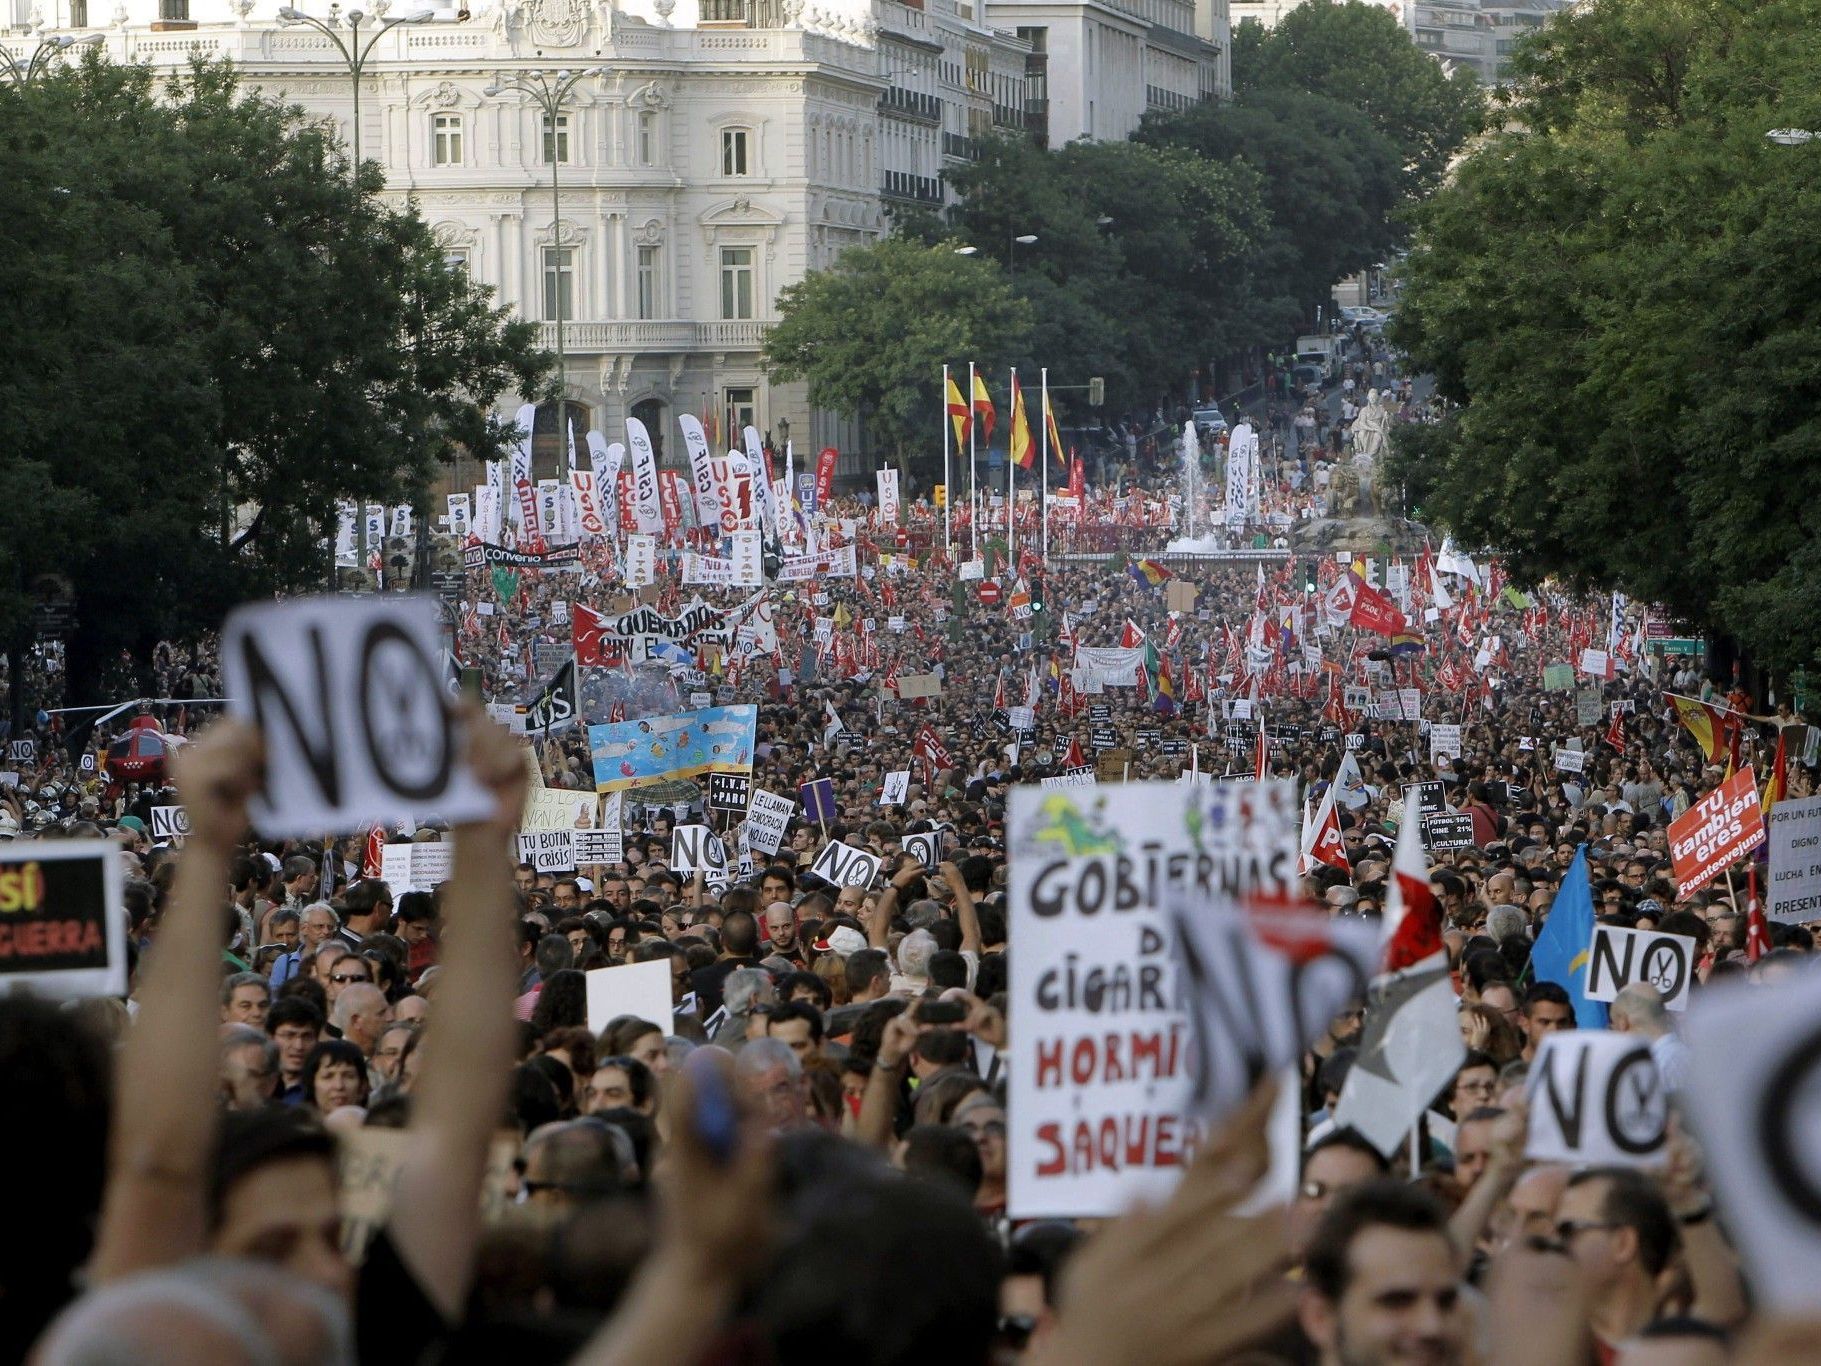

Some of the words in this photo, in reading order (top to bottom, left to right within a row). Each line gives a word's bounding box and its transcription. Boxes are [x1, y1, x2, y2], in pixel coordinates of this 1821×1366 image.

[882, 472, 896, 514] USO
[1014, 603, 1031, 618] NO
[1361, 602, 1381, 615] PSOE
[617, 606, 726, 639] QUEMADOS
[737, 640, 753, 655] NO
[1306, 660, 1320, 674] NO
[243, 620, 454, 812] NO
[11, 741, 34, 759] NO
[922, 730, 954, 767] CCOO
[1346, 735, 1364, 748] NO
[763, 797, 791, 817] LLAMAN
[1696, 788, 1725, 821] TÚ
[153, 807, 193, 834] NO
[1455, 815, 1471, 823] 10%
[1672, 790, 1757, 862] también
[1771, 812, 1789, 823] POR
[1791, 810, 1805, 820] UN
[1456, 825, 1472, 833] 21%
[521, 835, 536, 850] TU
[672, 827, 726, 869] NO
[1432, 838, 1473, 849] ¿CULTURA?
[1696, 818, 1744, 863] eres
[1791, 836, 1819, 849] DIGNO
[815, 841, 876, 891] NO
[1678, 827, 1766, 896] Fuenteovejuna
[1775, 869, 1804, 882] LUCHA
[1588, 928, 1687, 1003] NO
[1540, 1044, 1669, 1156] NO
